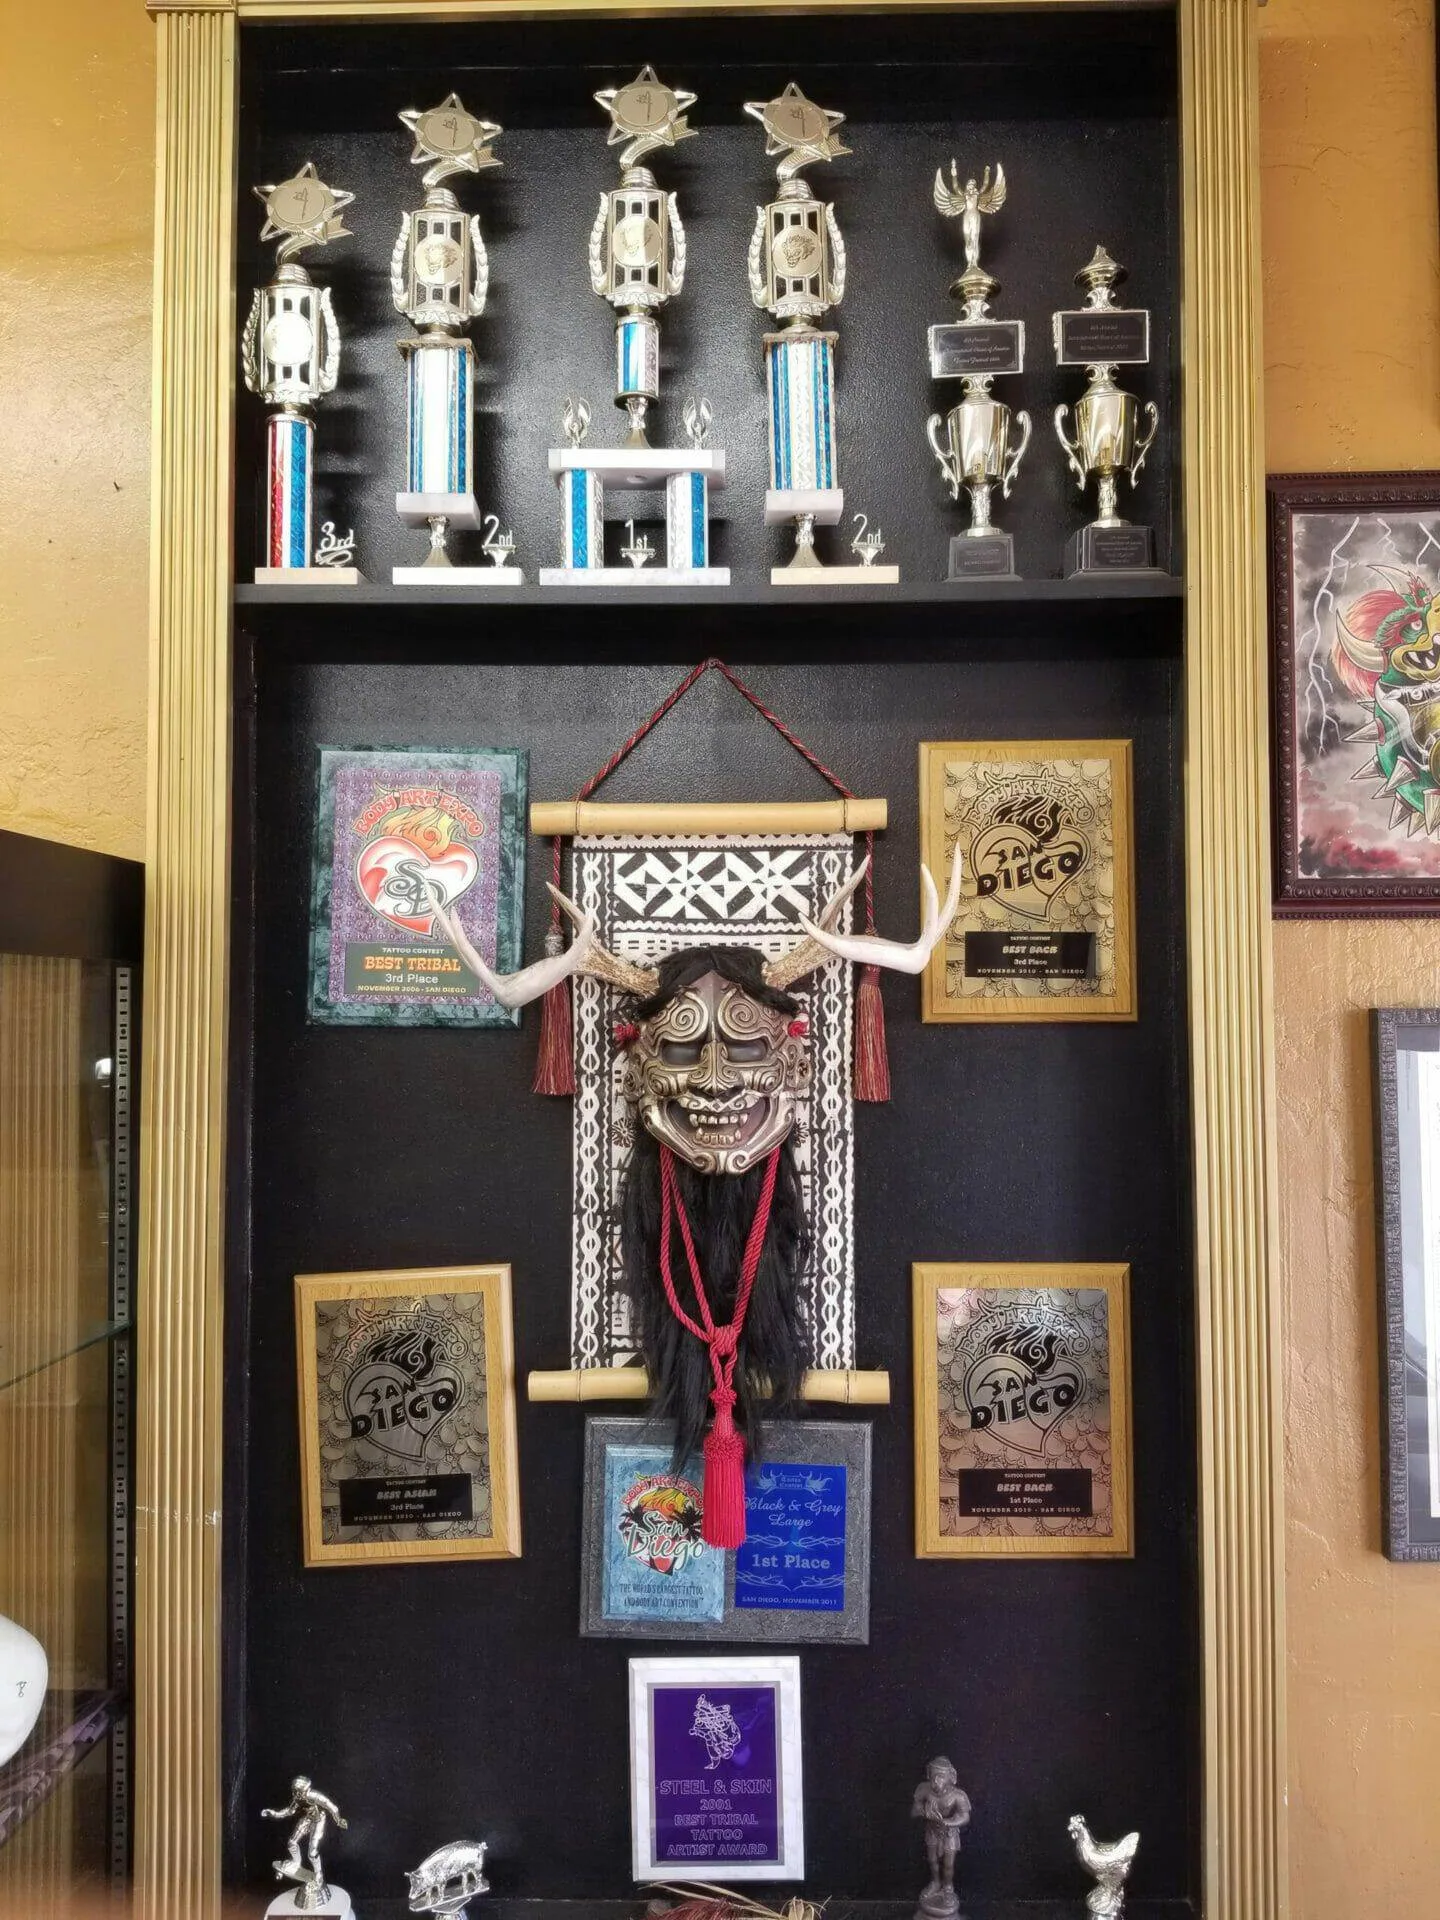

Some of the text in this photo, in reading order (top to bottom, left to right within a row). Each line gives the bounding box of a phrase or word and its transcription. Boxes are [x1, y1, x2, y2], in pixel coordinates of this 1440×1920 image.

[321, 521, 354, 549] 3rd
[483, 515, 514, 547] 2nd
[625, 519, 649, 550] 1st
[853, 513, 881, 545] 2nd
[998, 841, 1043, 864] SAN
[977, 852, 1081, 897] DIEGO
[1002, 945, 1058, 954] BEST BACK
[364, 956, 462, 972] BEST TRIBAL
[385, 973, 439, 984] 3rd Place
[371, 1378, 416, 1404] SAN
[992, 1373, 1038, 1396] SAN
[351, 1388, 454, 1438] DIEGO
[971, 1384, 1075, 1429] DIEGO
[376, 1489, 437, 1500] BEST ASIAN
[997, 1483, 1053, 1492] BEST BACK
[745, 1496, 843, 1517] Black & Grey
[644, 1511, 688, 1536] San
[769, 1513, 813, 1529] Large
[626, 1523, 705, 1569] Diego
[752, 1554, 831, 1569] 1st Place
[660, 1779, 772, 1795] STEEL & SKIN
[700, 1799, 733, 1811] 2001
[674, 1814, 759, 1826] BEST TRIBAL
[690, 1829, 744, 1841] TATTOO
[666, 1844, 768, 1856] ARTIST AWARD
